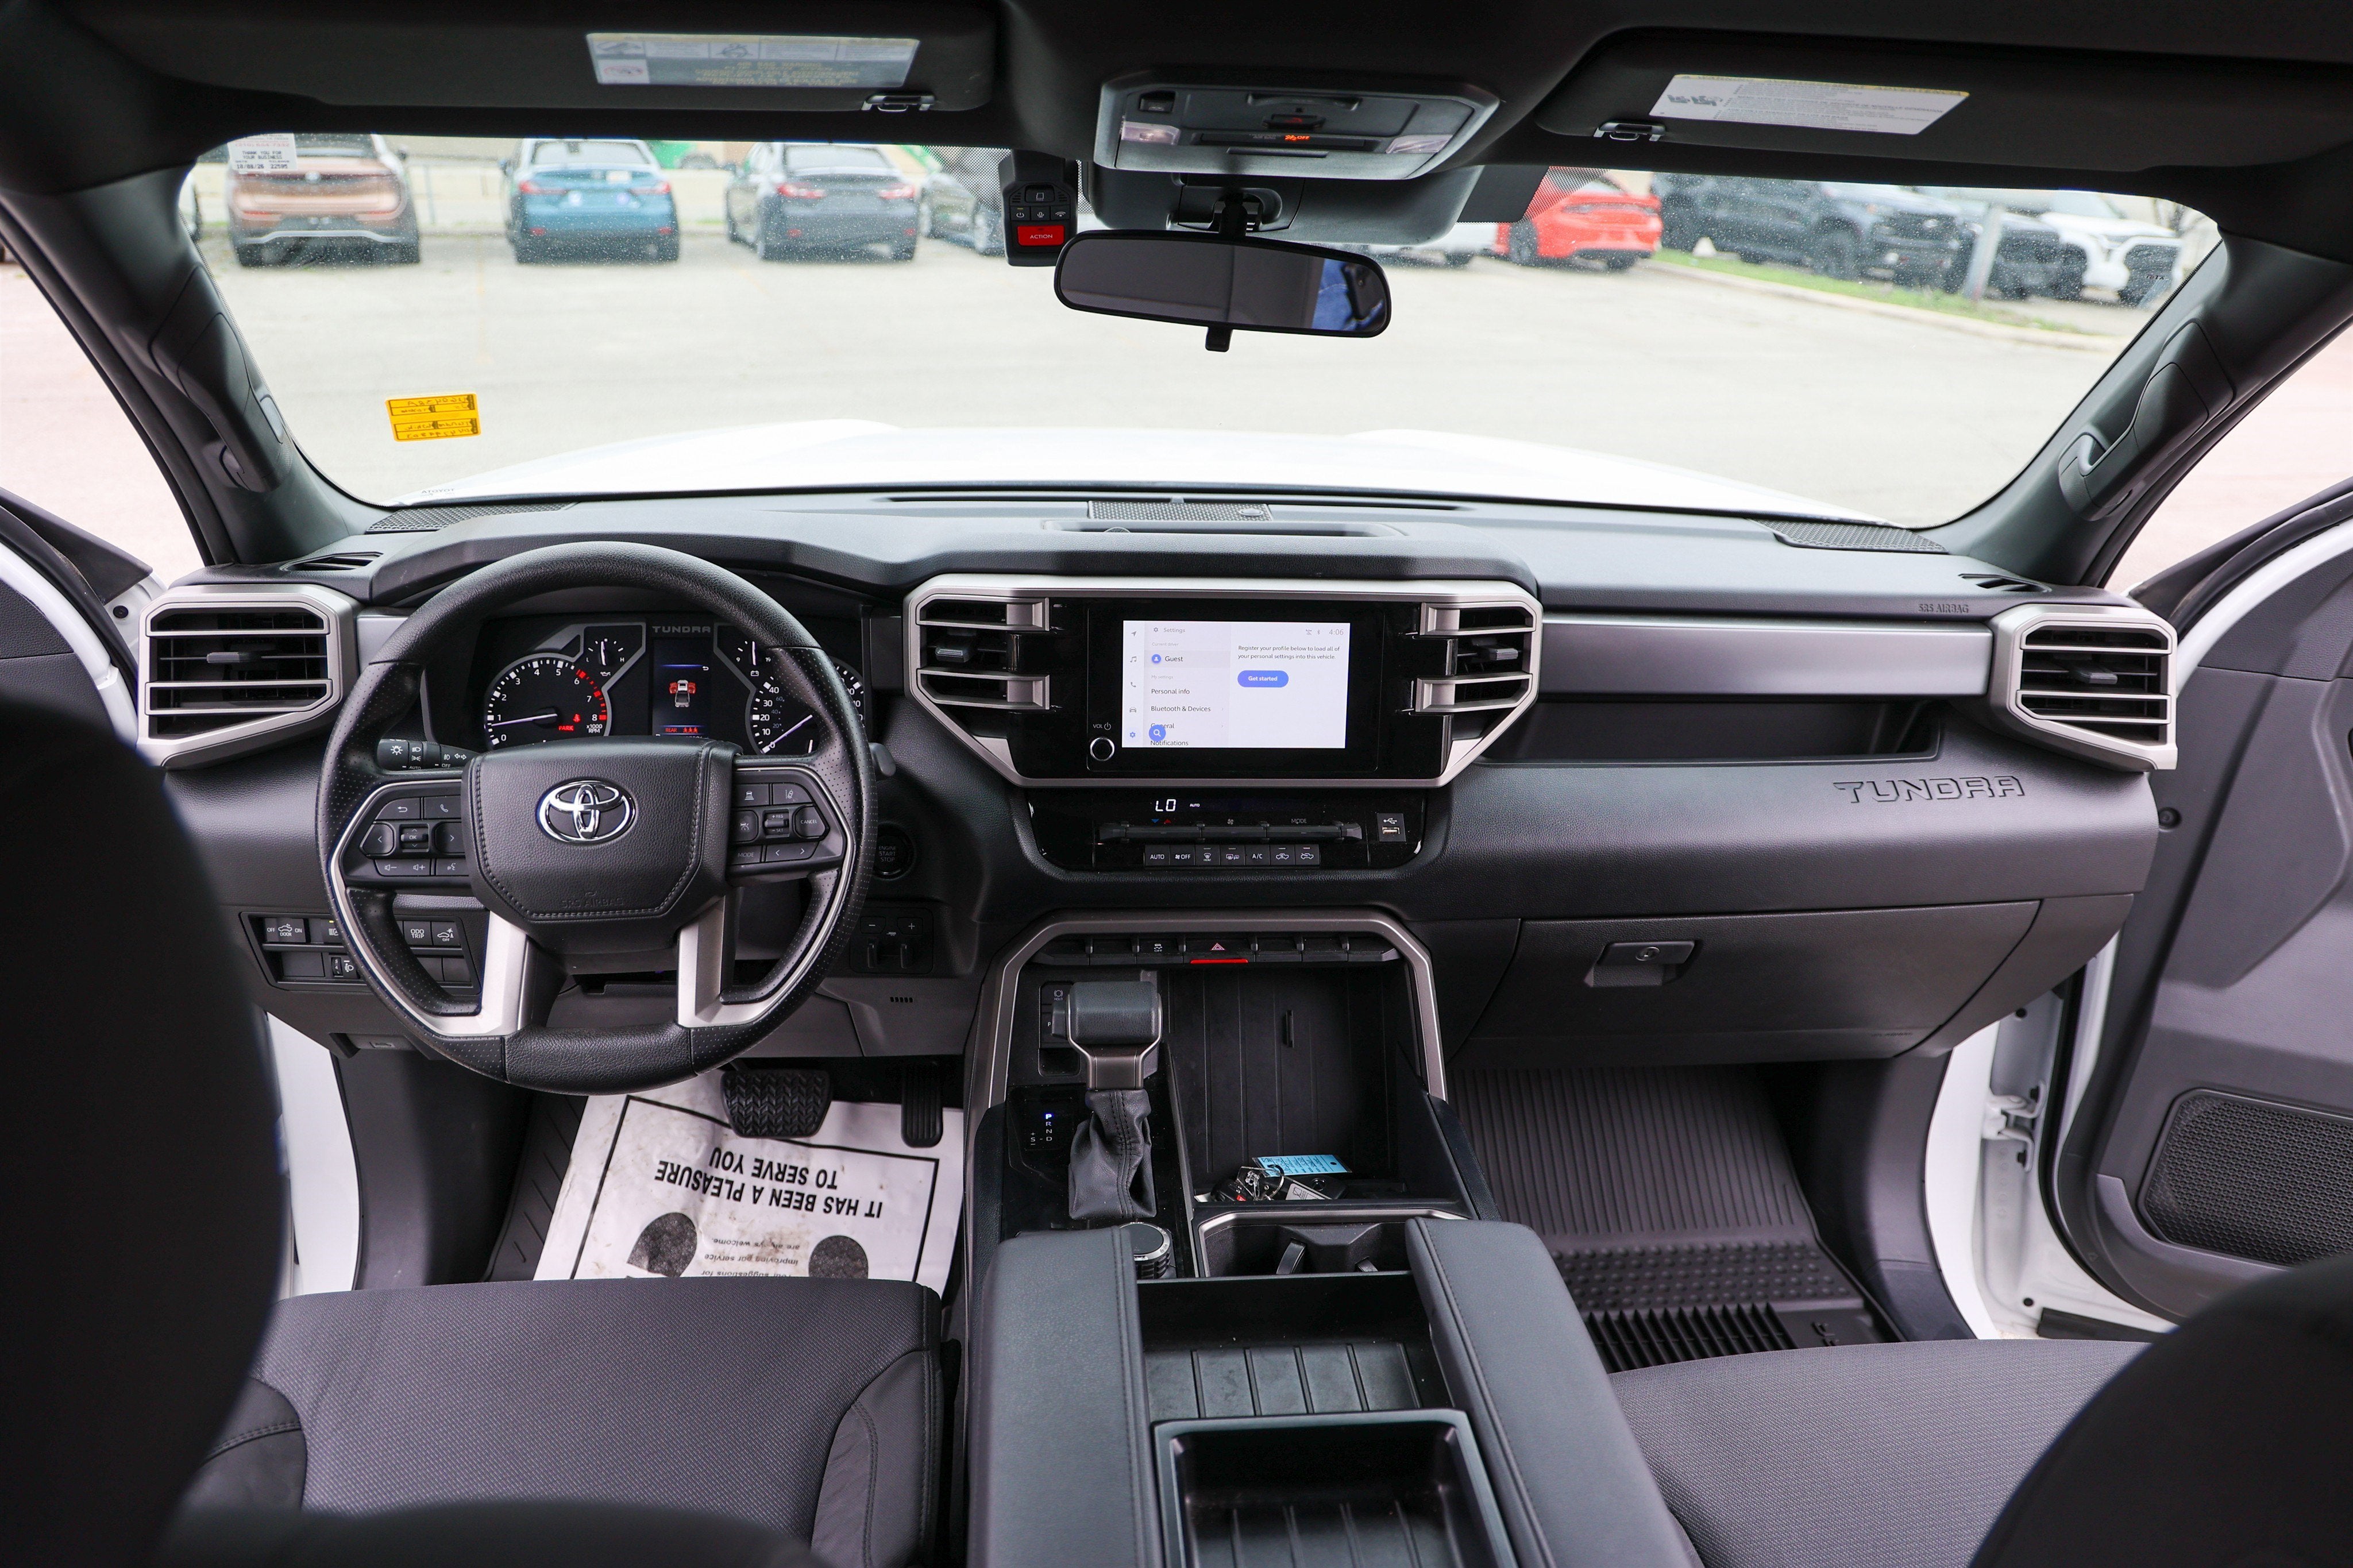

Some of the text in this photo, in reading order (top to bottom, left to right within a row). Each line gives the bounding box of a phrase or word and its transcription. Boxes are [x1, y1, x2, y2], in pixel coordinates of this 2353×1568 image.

[1918, 604, 1969, 613] SRS AIRBAG
[1833, 775, 2025, 803] TUNDRA
[1155, 798, 1176, 812] LO
[708, 1147, 838, 1190] TO SERVE YOU
[654, 1160, 883, 1218] IT HAS BEEN A PLEASURE
[712, 1238, 750, 1246] welcome.
[704, 1253, 735, 1261] service
[755, 1254, 799, 1266] improving
